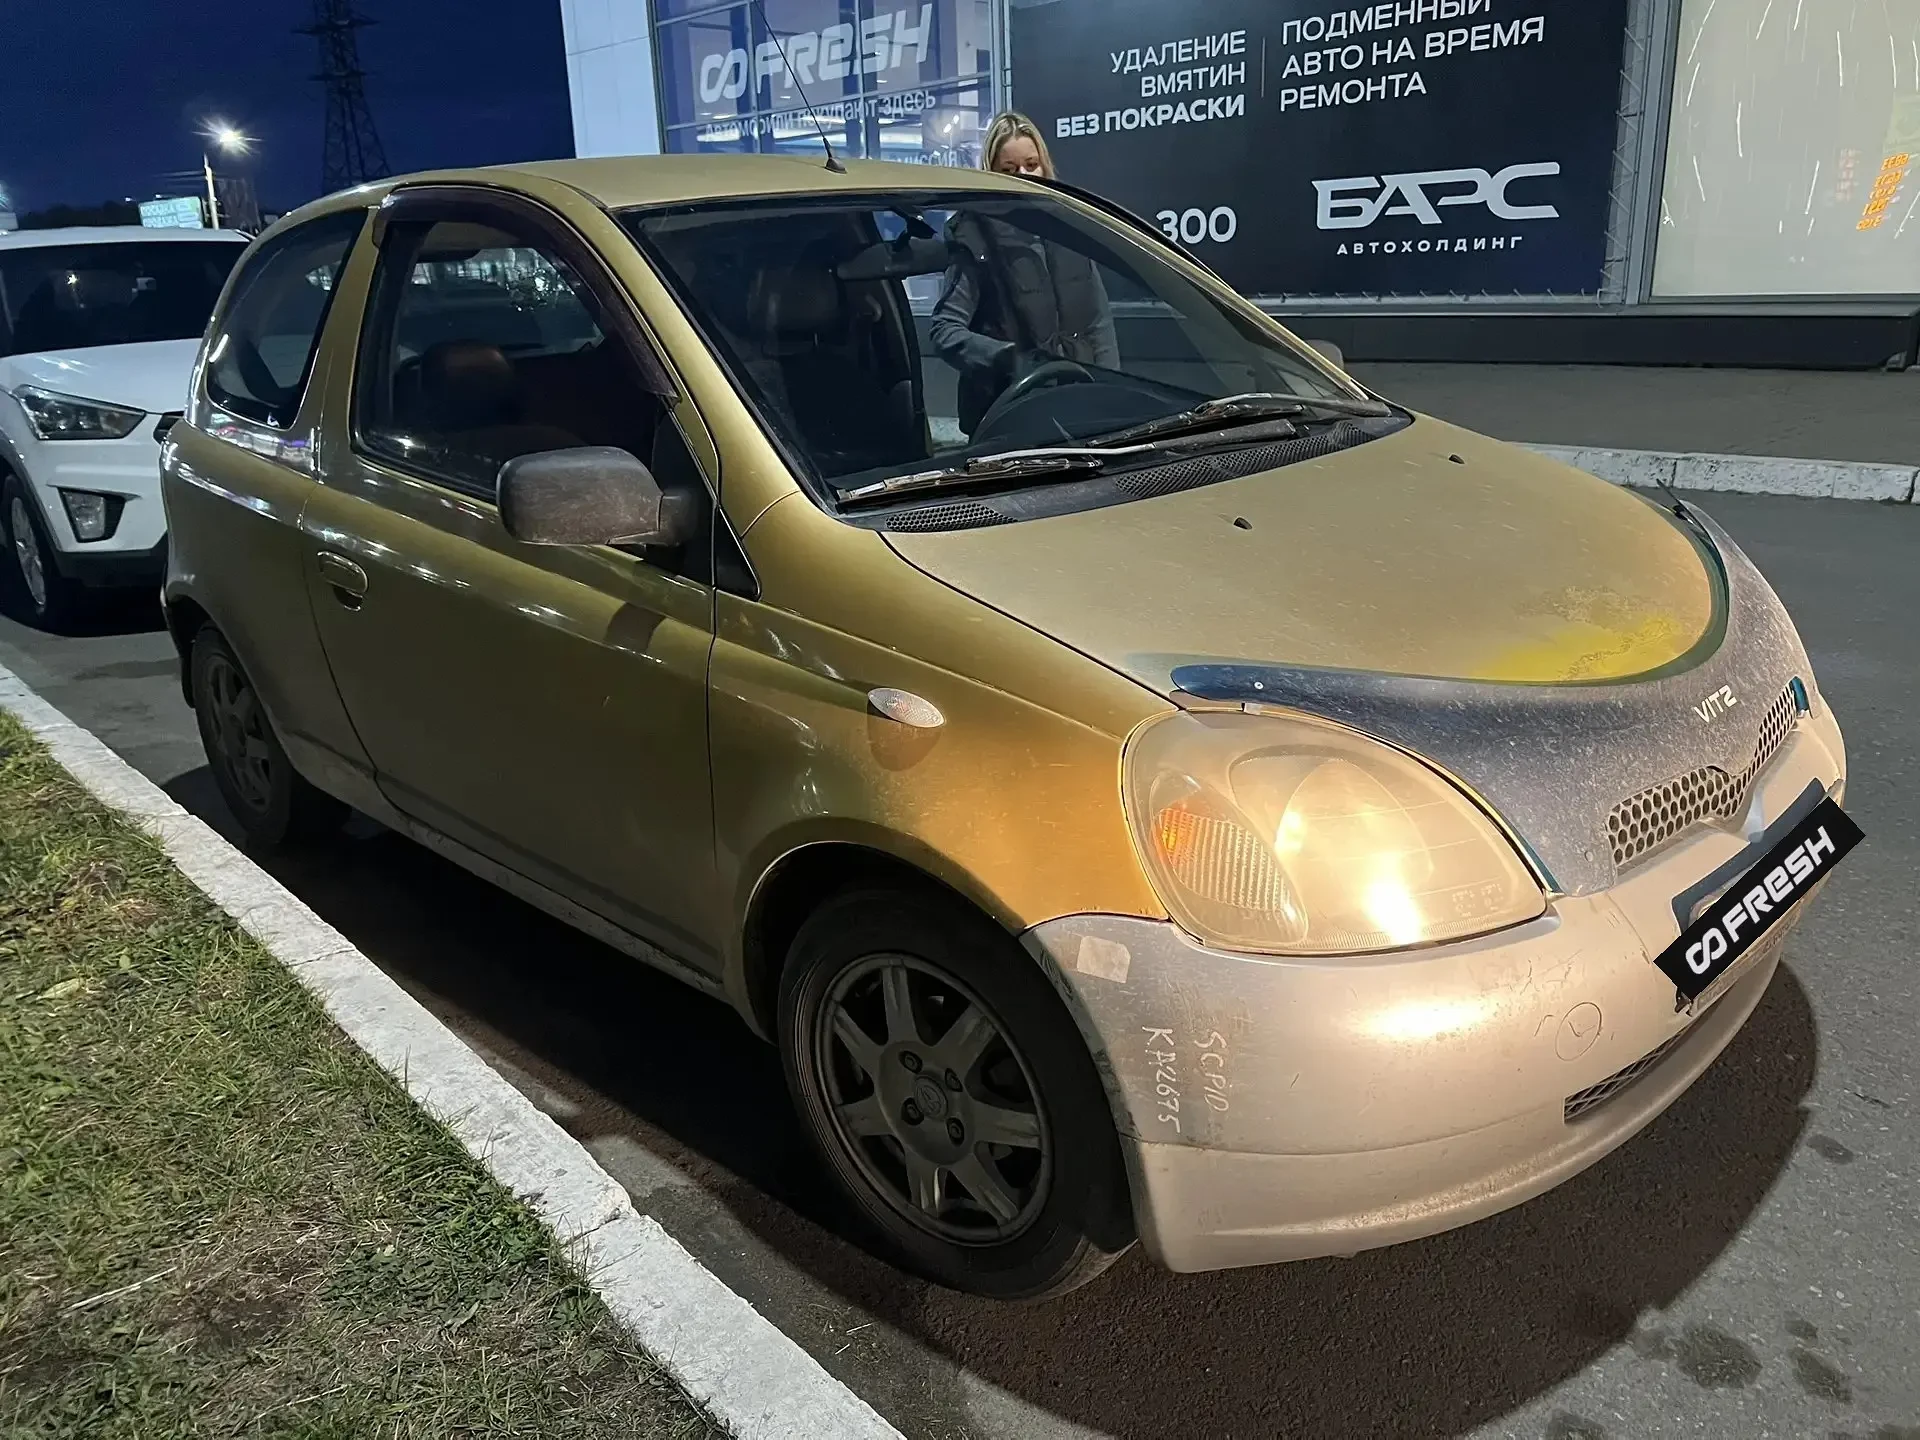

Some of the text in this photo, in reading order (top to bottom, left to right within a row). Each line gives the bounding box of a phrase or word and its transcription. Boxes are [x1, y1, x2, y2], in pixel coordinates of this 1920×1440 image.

[1110, 30, 1246, 74] УДАЛЕНИЕ
[1281, 16, 1545, 79] АВТО НА ВРЕМЯ
[1140, 61, 1246, 98] ВМЯТИН
[1280, 71, 1427, 112] РЕМОНТА
[1056, 94, 1245, 138] БЕЗ ПОКРАСКИ
[1311, 161, 1561, 230] БАРС
[1156, 206, 1237, 244] 300
[1336, 236, 1523, 255] АВТОХОЛДИНГ
[1693, 684, 1738, 723] VITZ
